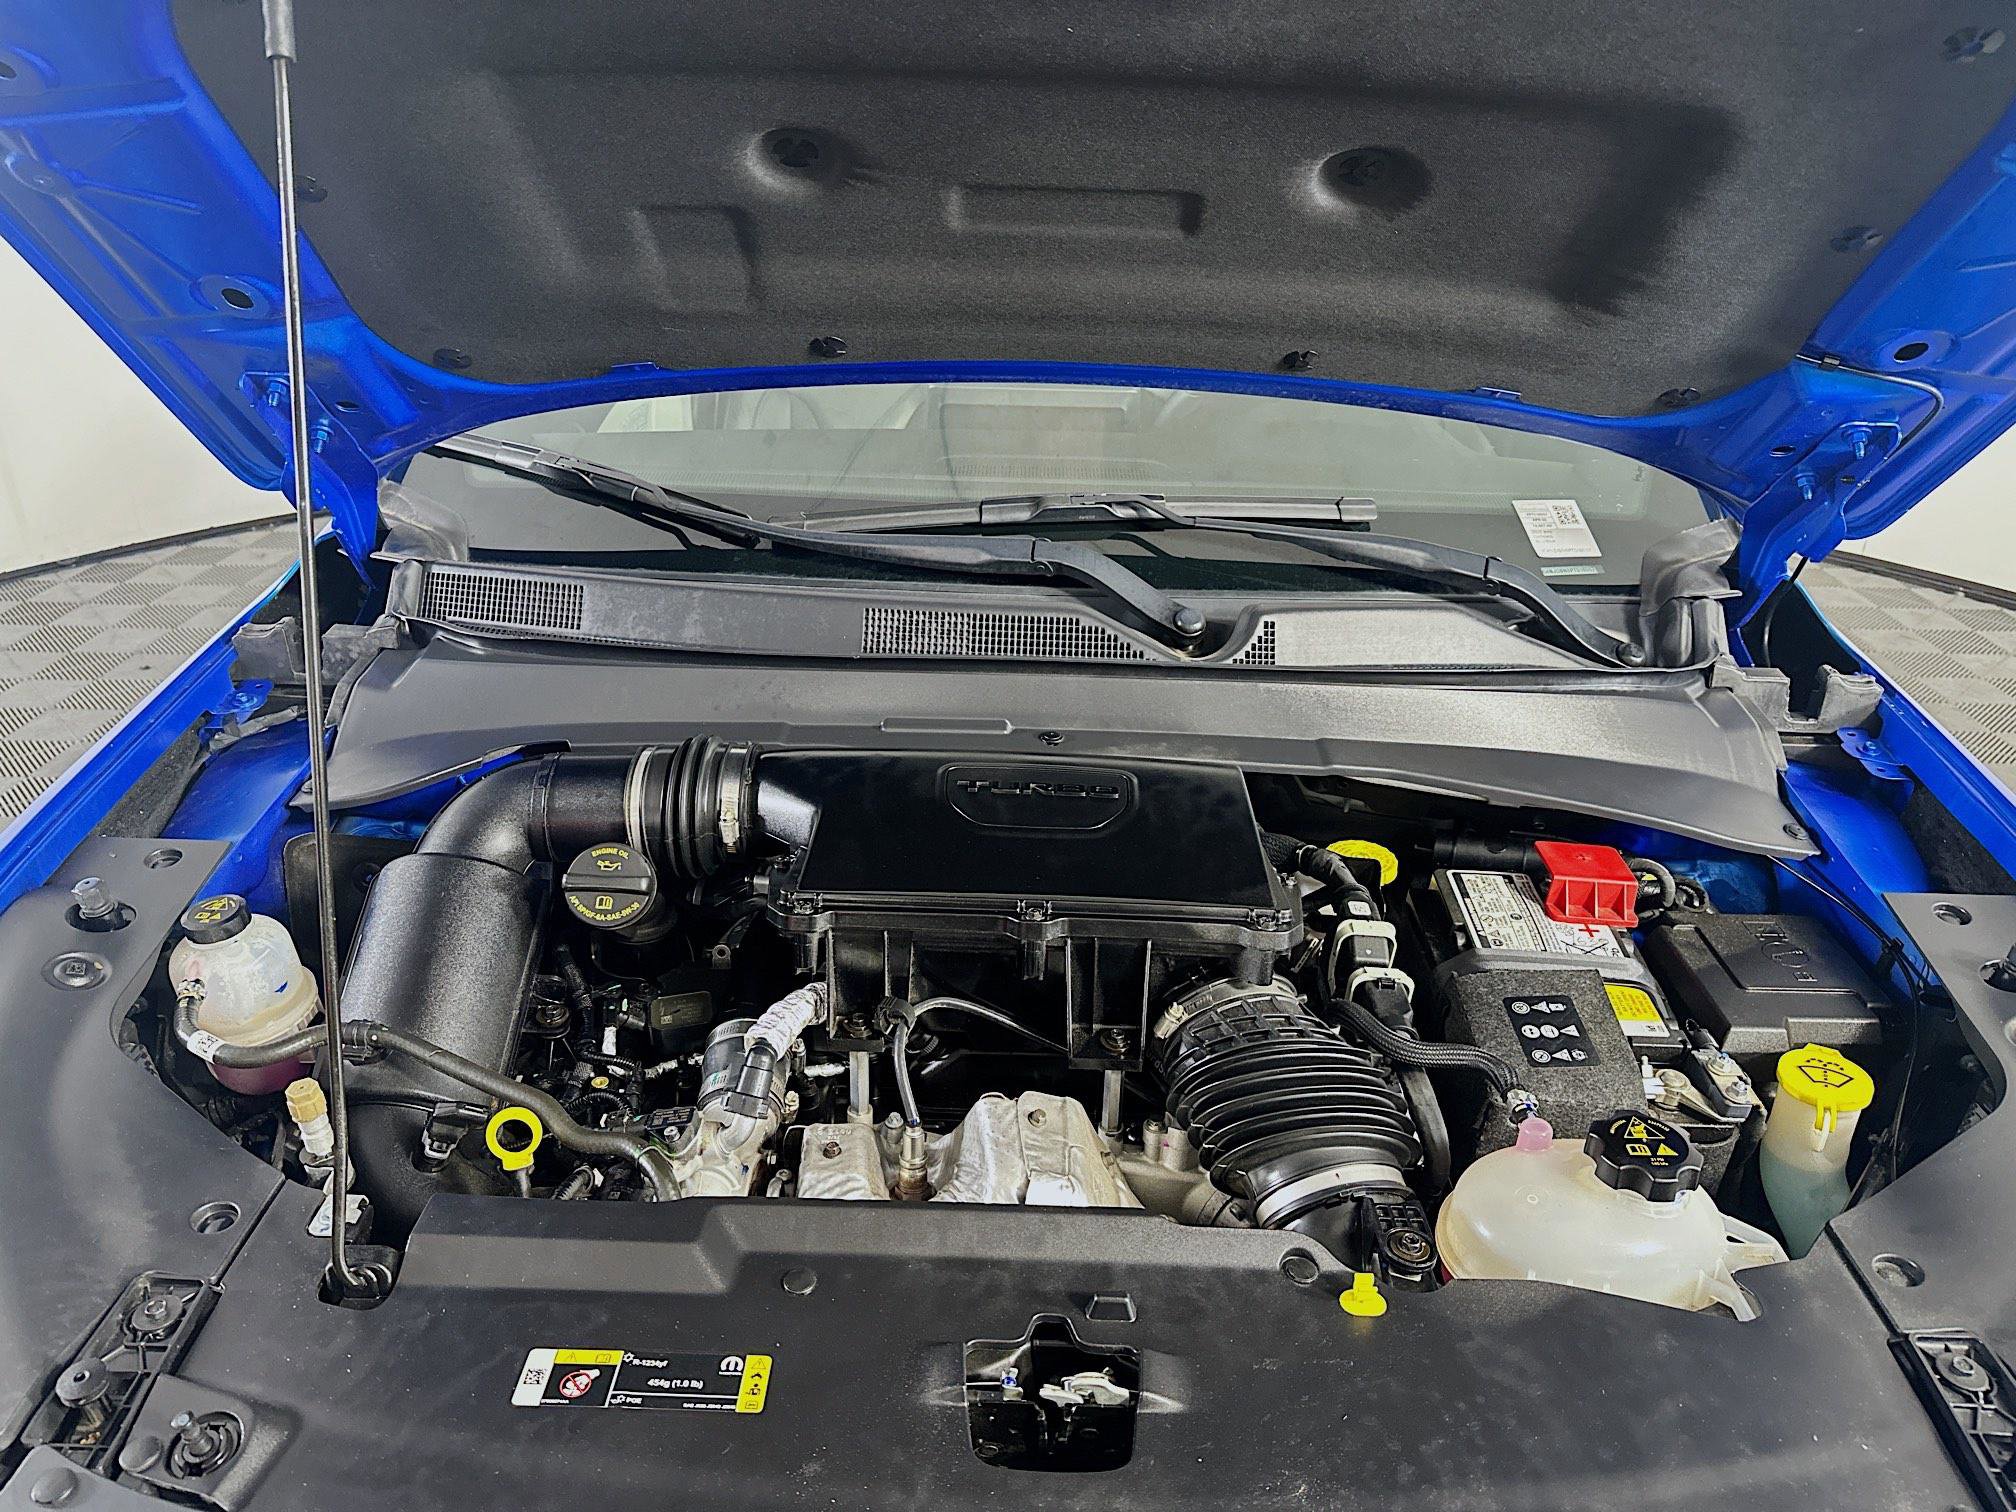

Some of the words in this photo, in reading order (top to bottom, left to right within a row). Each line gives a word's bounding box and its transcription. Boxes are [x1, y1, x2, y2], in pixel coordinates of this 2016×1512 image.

[956, 780, 1119, 799] TURBO
[591, 848, 618, 857] ENGINE
[618, 850, 628, 859] OIL
[569, 895, 580, 907] API
[647, 1378, 671, 1389] 454g
[690, 1380, 704, 1390] lb)
